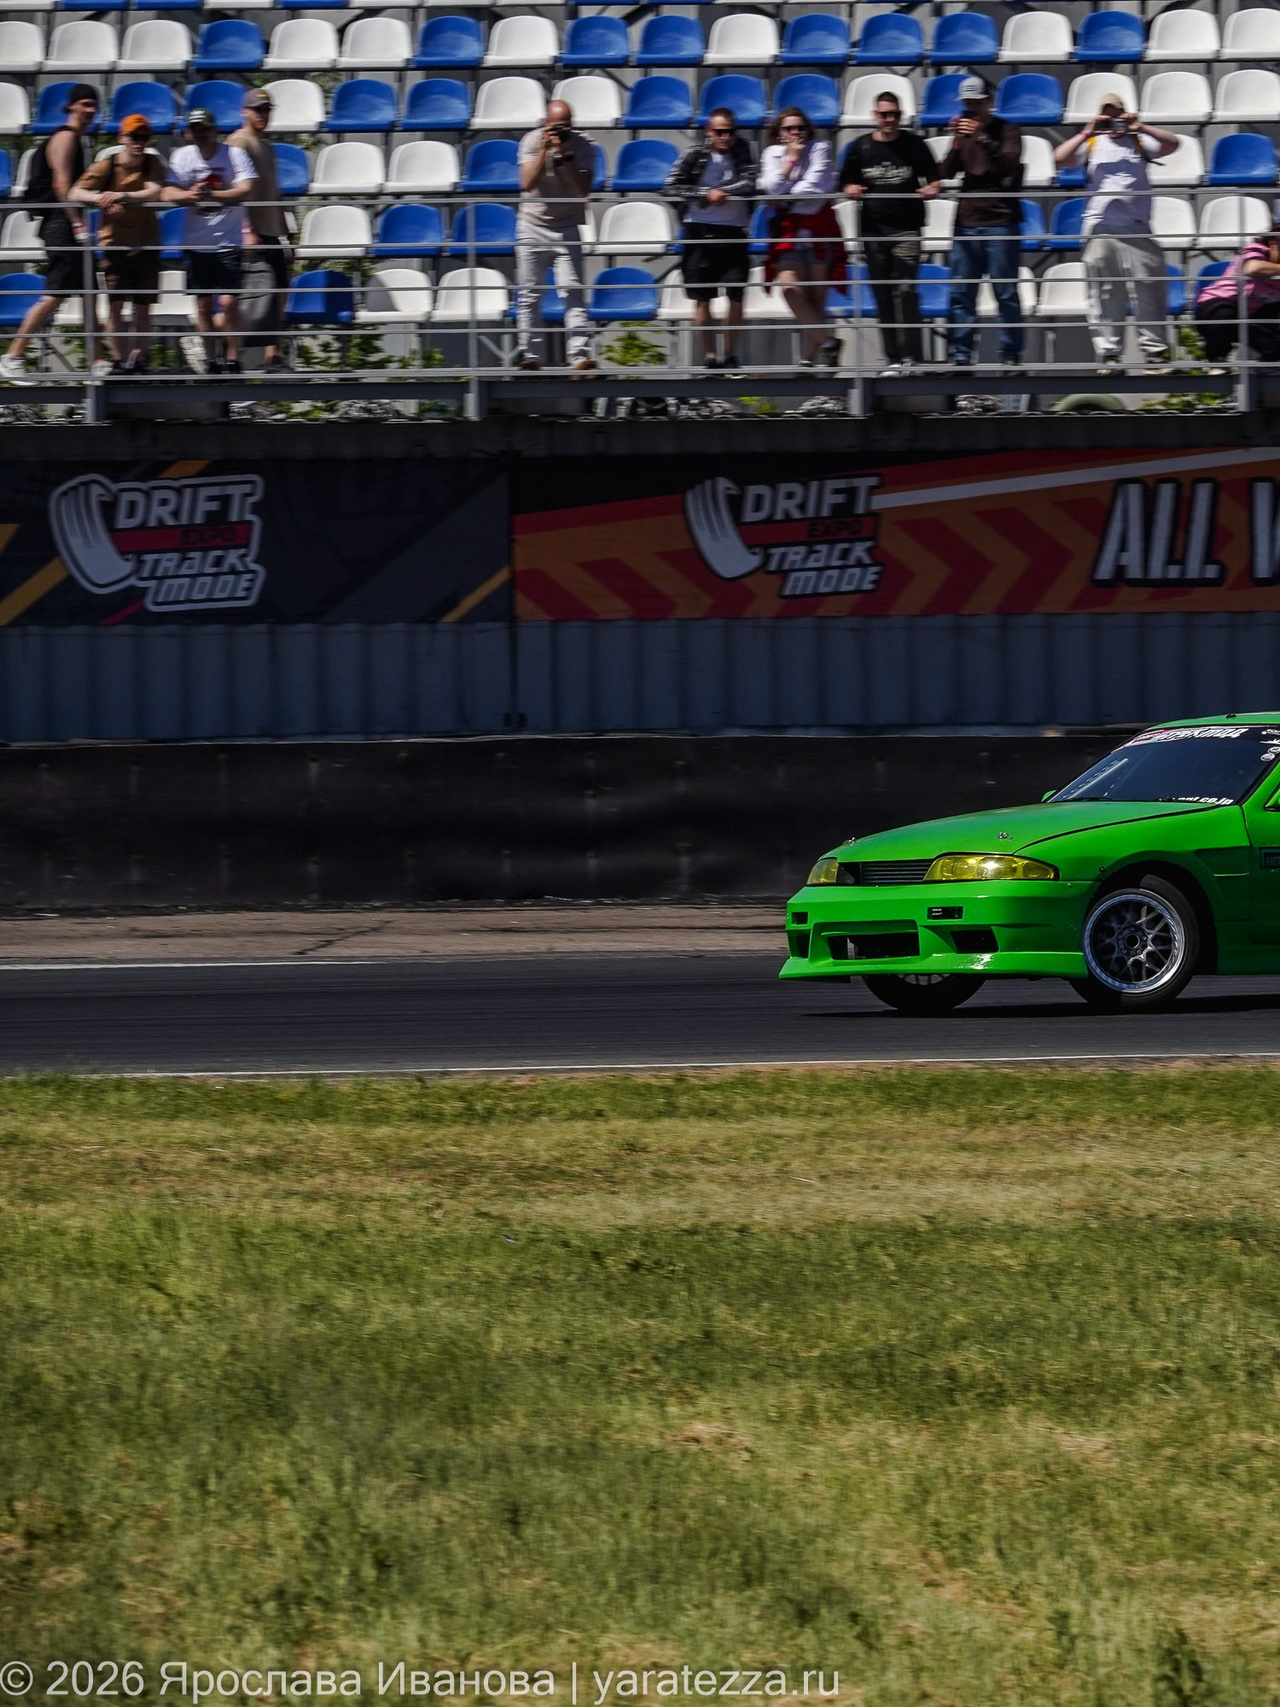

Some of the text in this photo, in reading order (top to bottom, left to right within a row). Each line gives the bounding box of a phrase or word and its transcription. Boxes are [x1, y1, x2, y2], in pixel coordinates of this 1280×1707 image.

[115, 483, 256, 529] DRIFT
[741, 476, 881, 522] DRIFT
[180, 526, 238, 546] EXPO
[806, 518, 864, 538] EXPO
[1093, 478, 1222, 580] ALL
